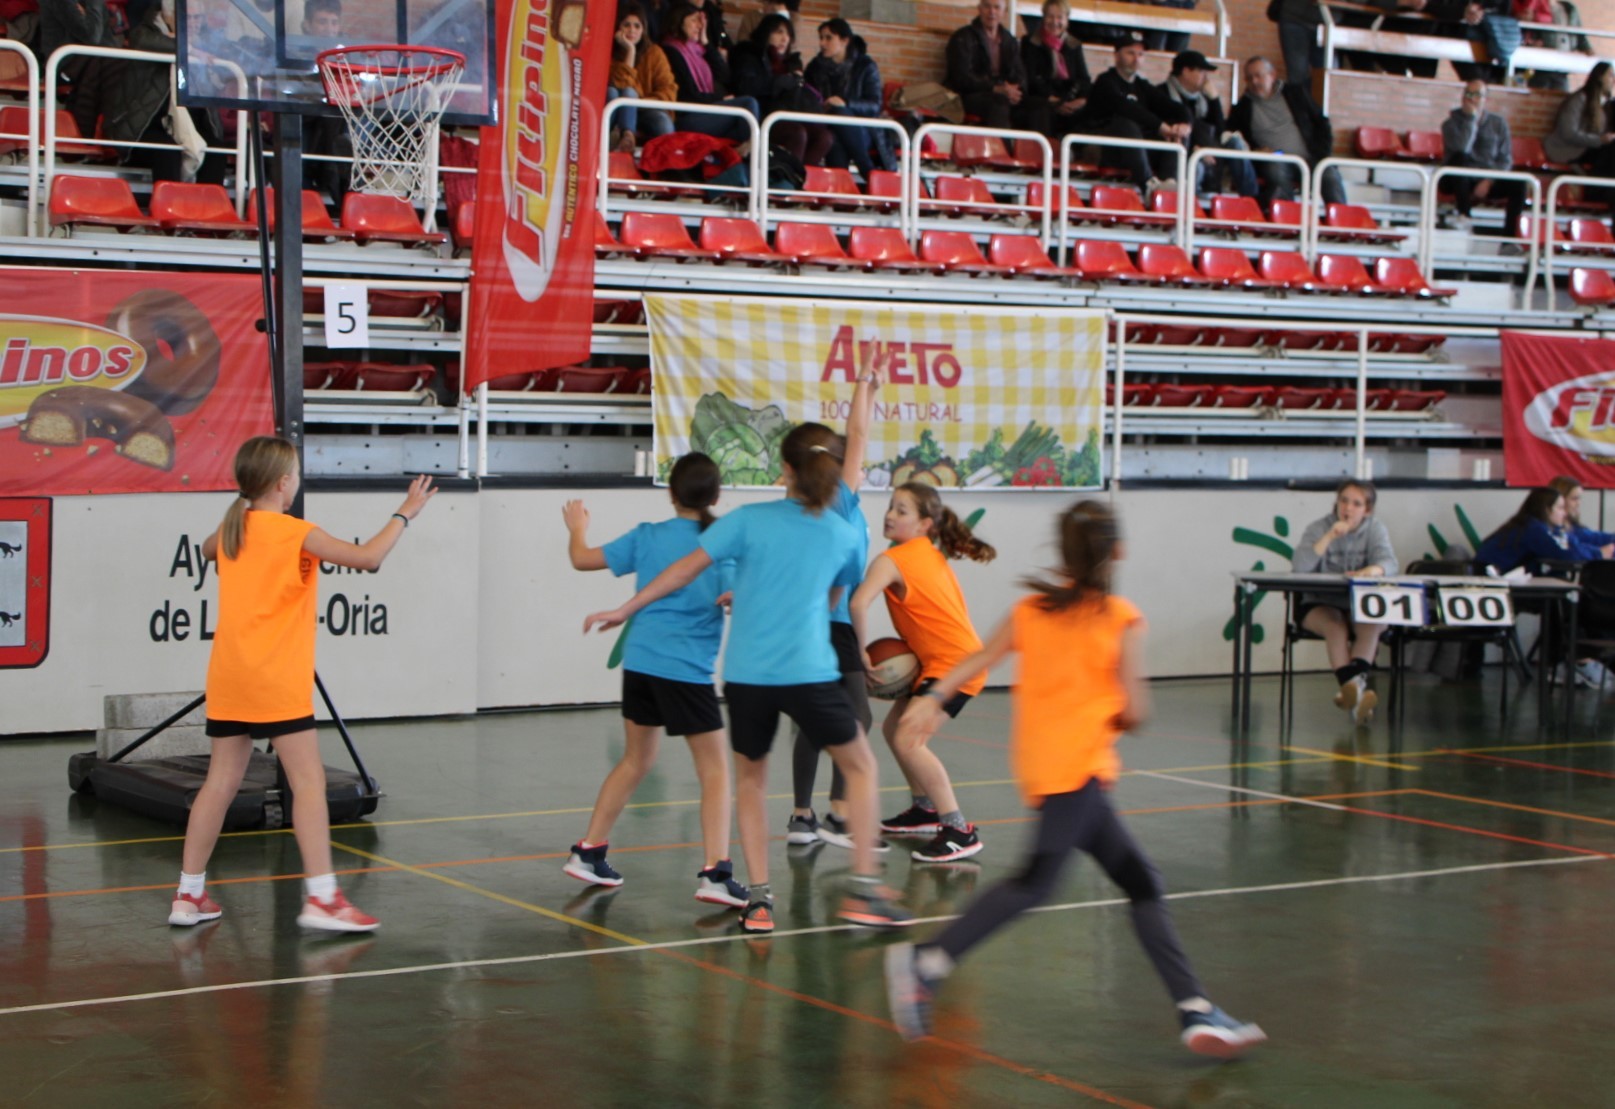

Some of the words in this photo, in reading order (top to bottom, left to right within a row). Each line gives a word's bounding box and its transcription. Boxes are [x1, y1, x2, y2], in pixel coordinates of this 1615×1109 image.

[337, 302, 356, 334] 5
[820, 400, 854, 420] 100
[873, 402, 962, 422] NATURAL
[1361, 593, 1412, 620] 01
[1448, 595, 1505, 621] 00
[149, 600, 191, 642] de
